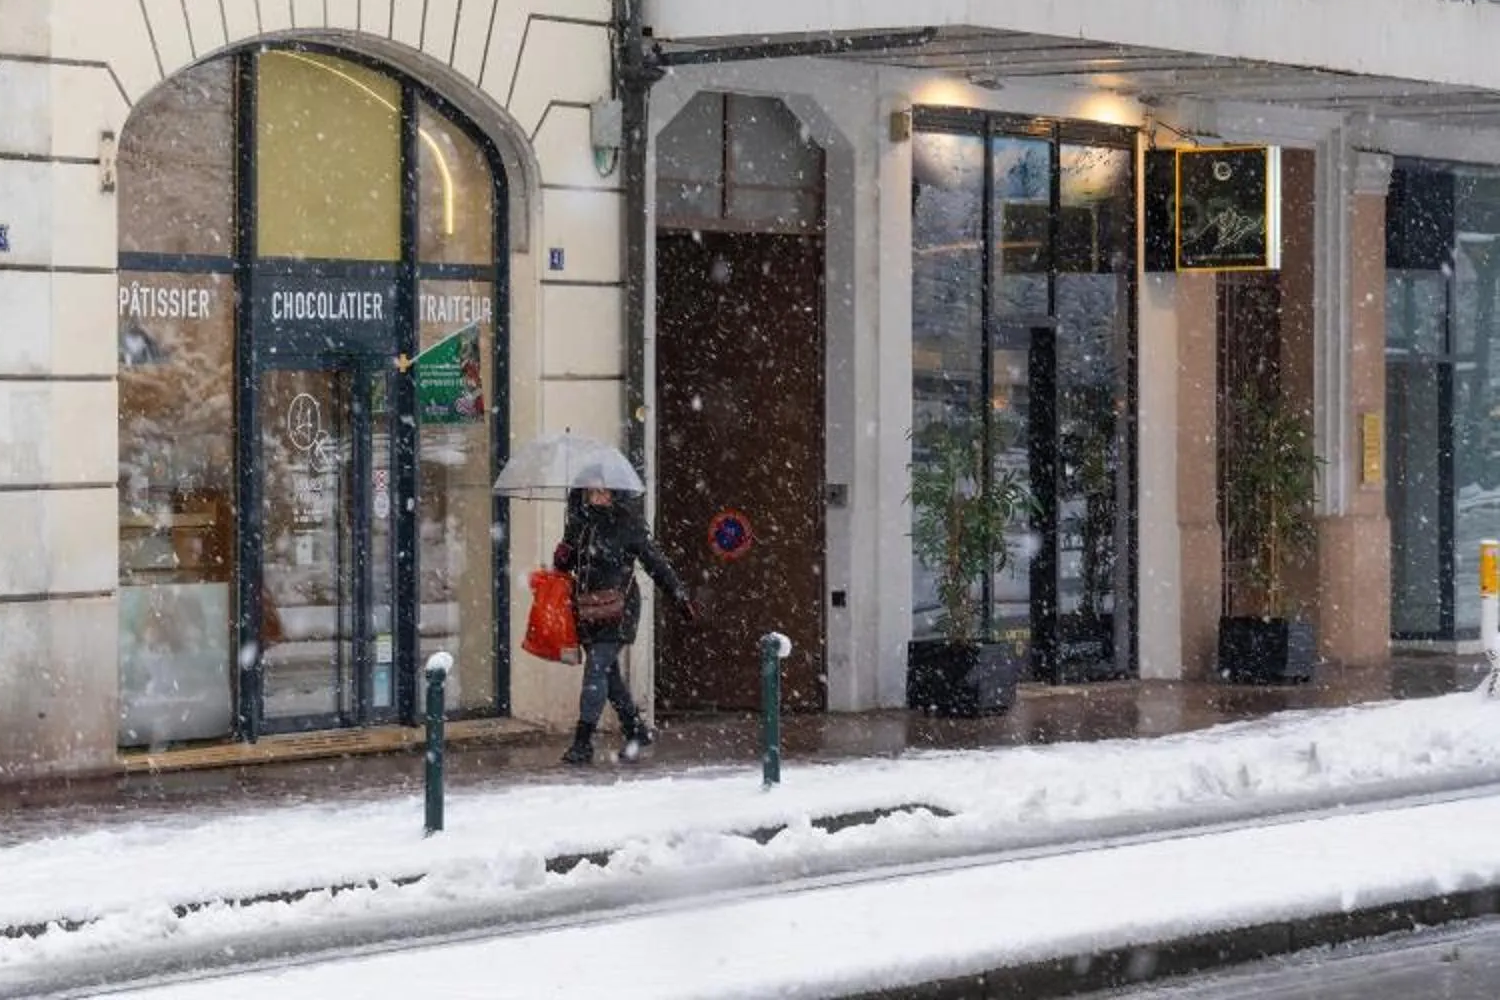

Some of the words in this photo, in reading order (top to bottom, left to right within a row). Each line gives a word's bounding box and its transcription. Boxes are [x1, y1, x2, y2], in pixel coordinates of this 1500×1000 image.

[119, 281, 211, 319] PÂTISSIER
[272, 291, 383, 320] CHOCOLATIER
[419, 295, 492, 324] TRAITEUR
